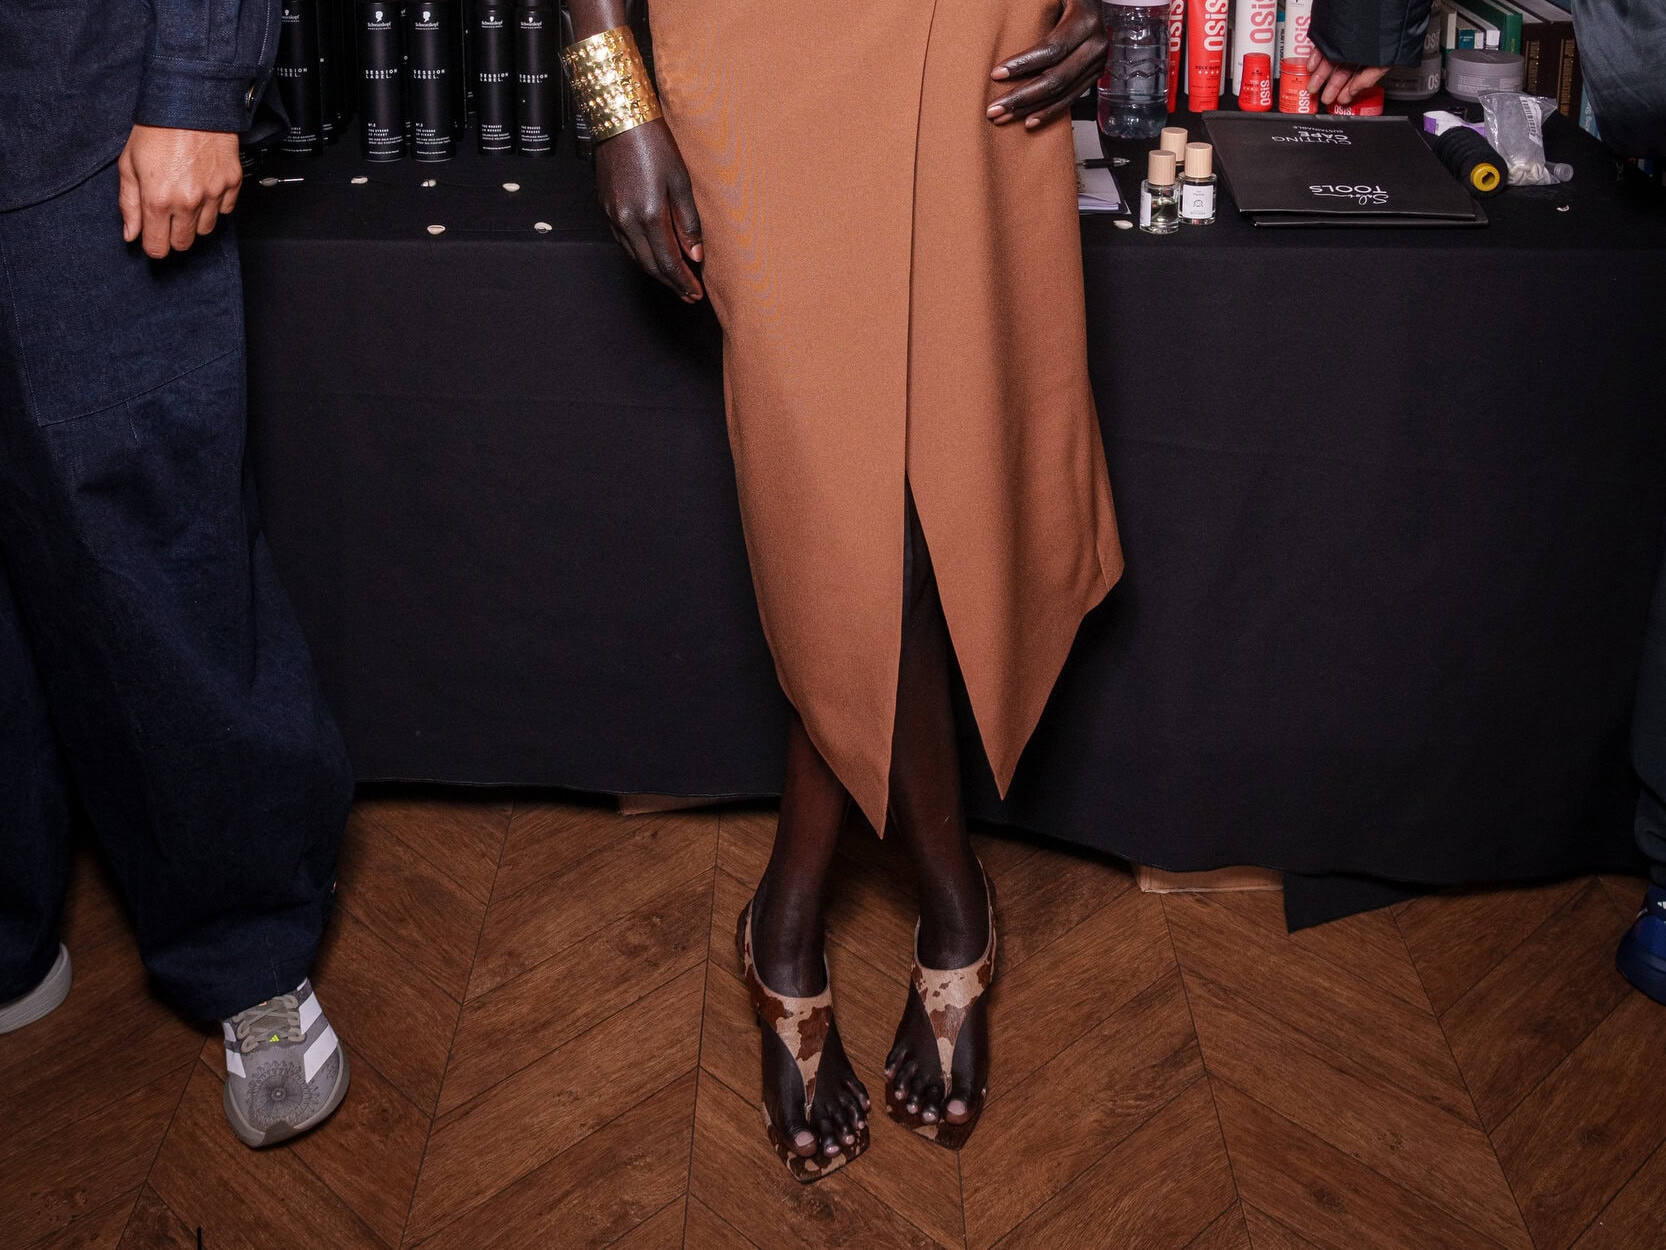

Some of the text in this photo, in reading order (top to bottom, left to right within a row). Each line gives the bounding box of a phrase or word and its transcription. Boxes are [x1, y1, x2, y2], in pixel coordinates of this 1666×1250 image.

[1298, 131, 1348, 140] CAPE
[1271, 136, 1351, 145] CUTTING
[1309, 184, 1387, 194] TOOLS
